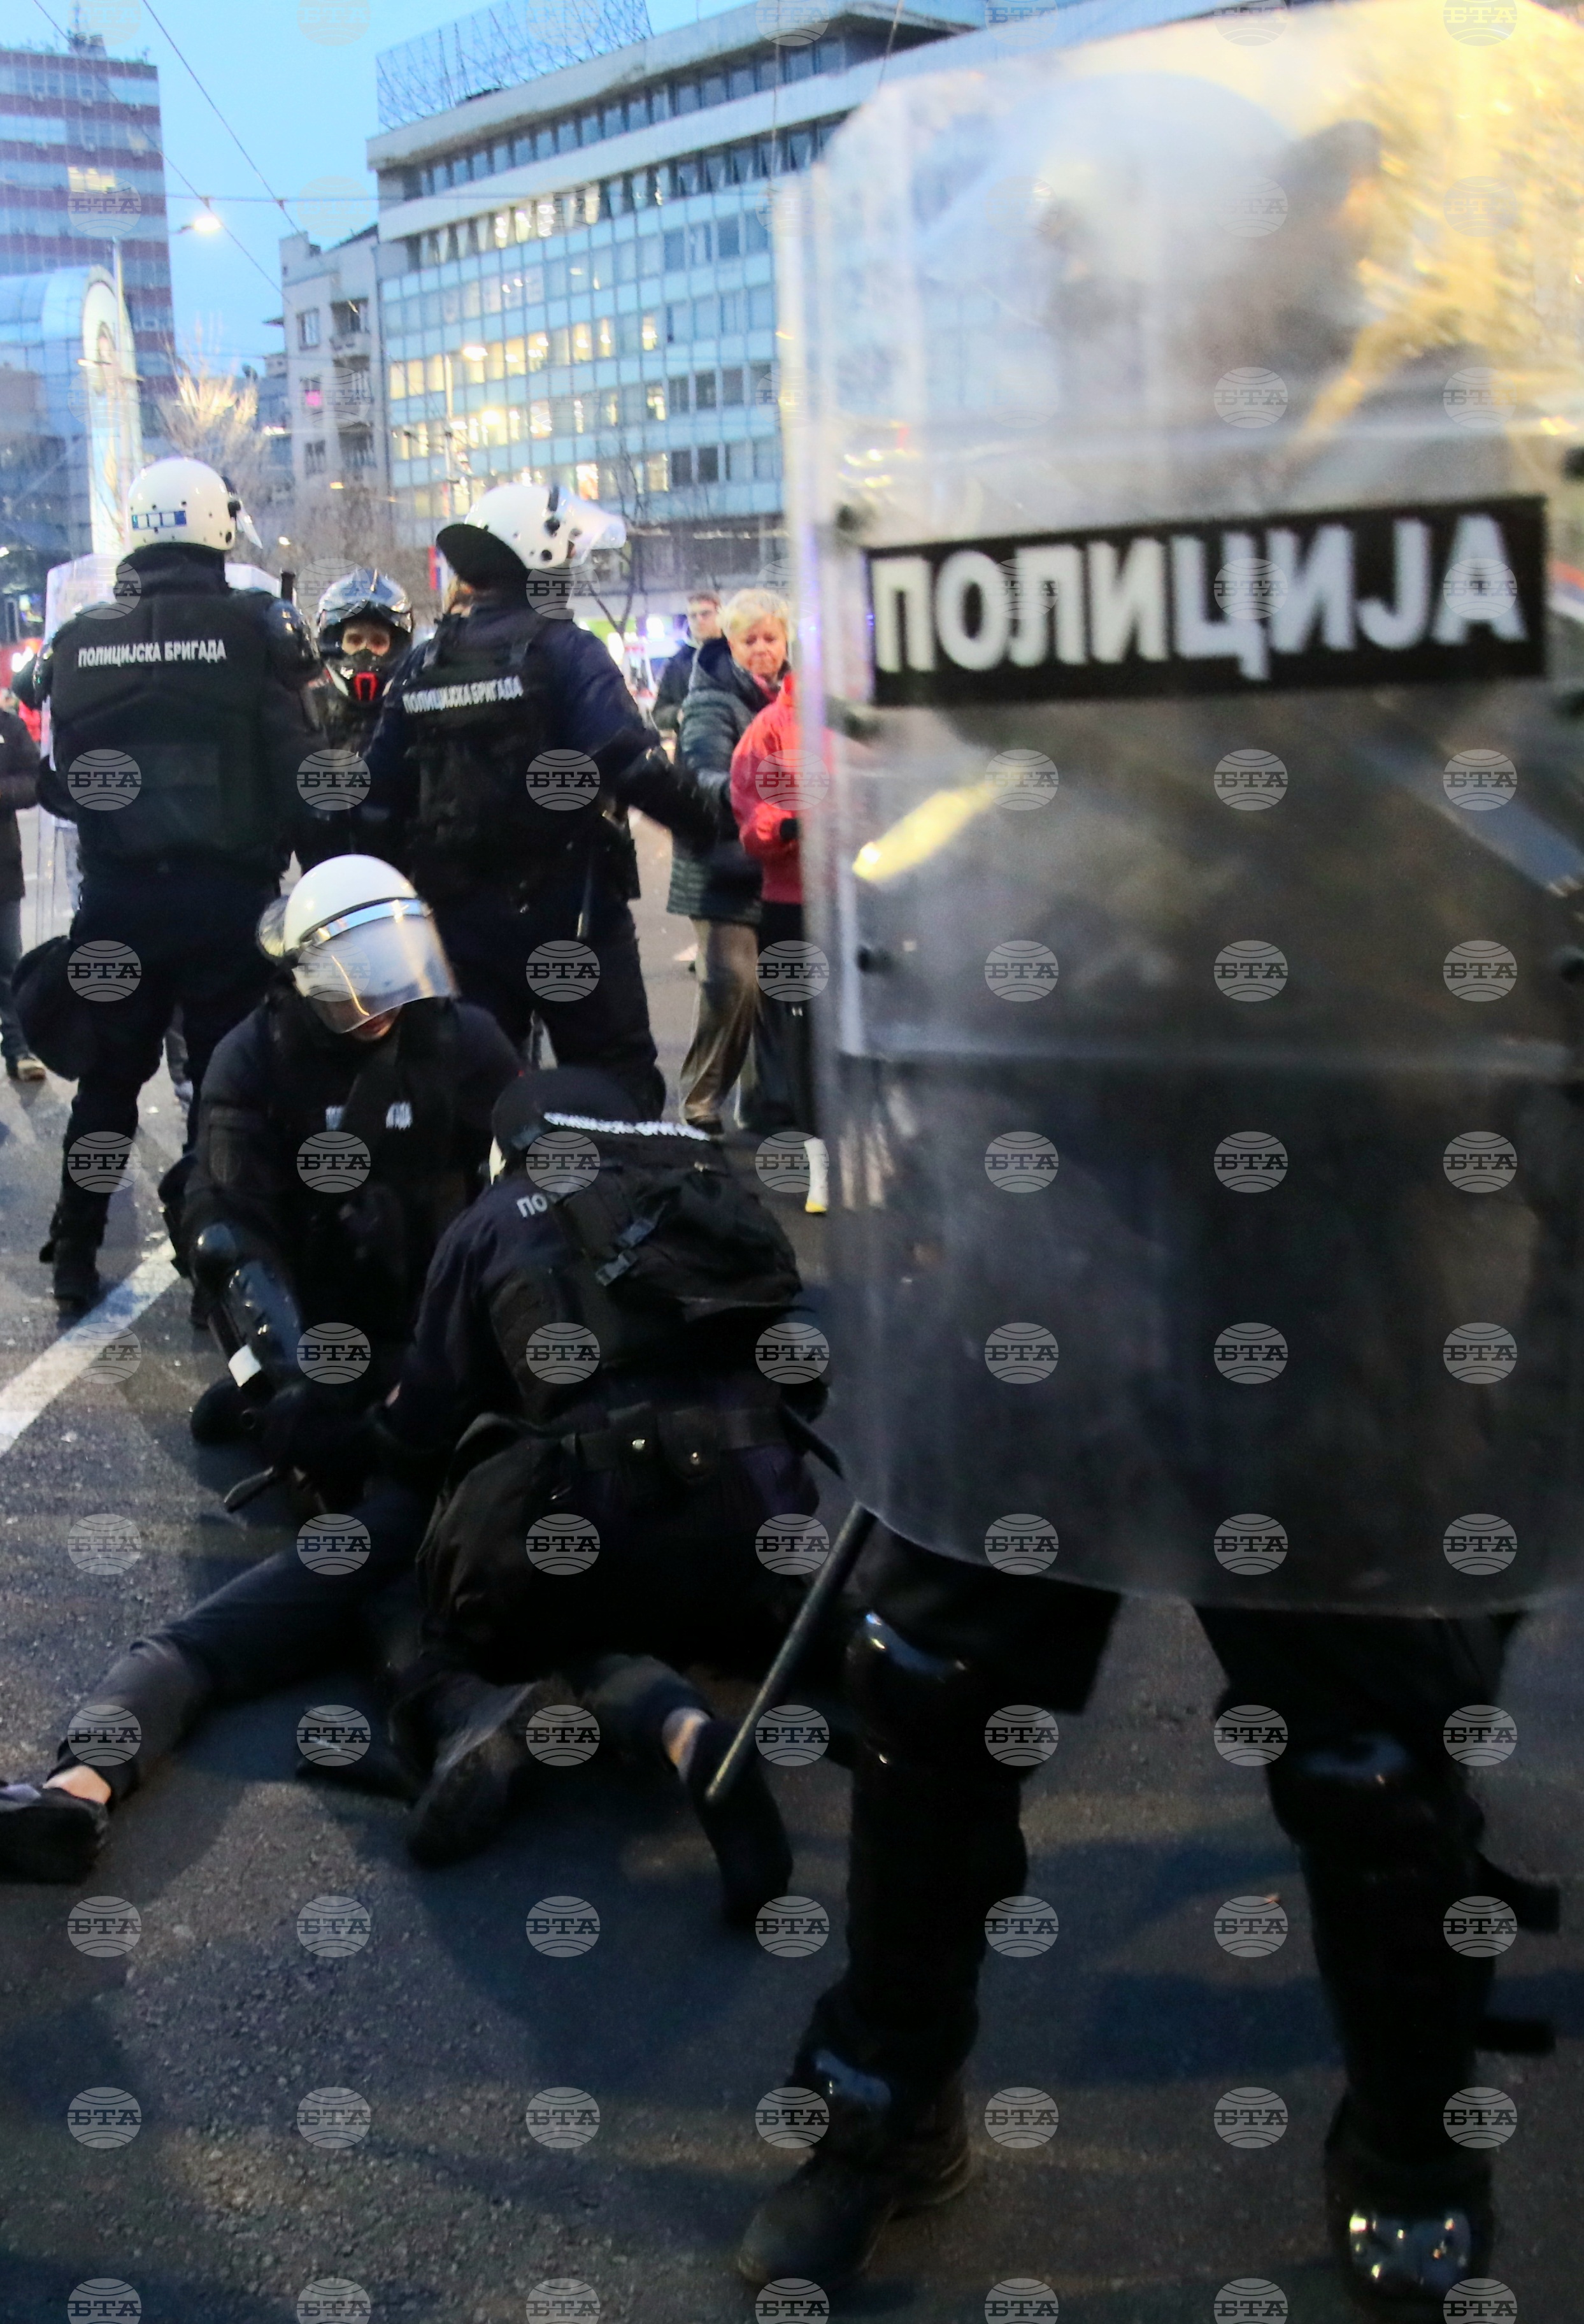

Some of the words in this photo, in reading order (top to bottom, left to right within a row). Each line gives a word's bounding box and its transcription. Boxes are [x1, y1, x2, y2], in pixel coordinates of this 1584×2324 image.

[870, 513, 1527, 681] ПОЛИЦИЈА
[78, 642, 162, 668] ПОЛИЦИЈСКА
[164, 639, 227, 663] БРИГАДА
